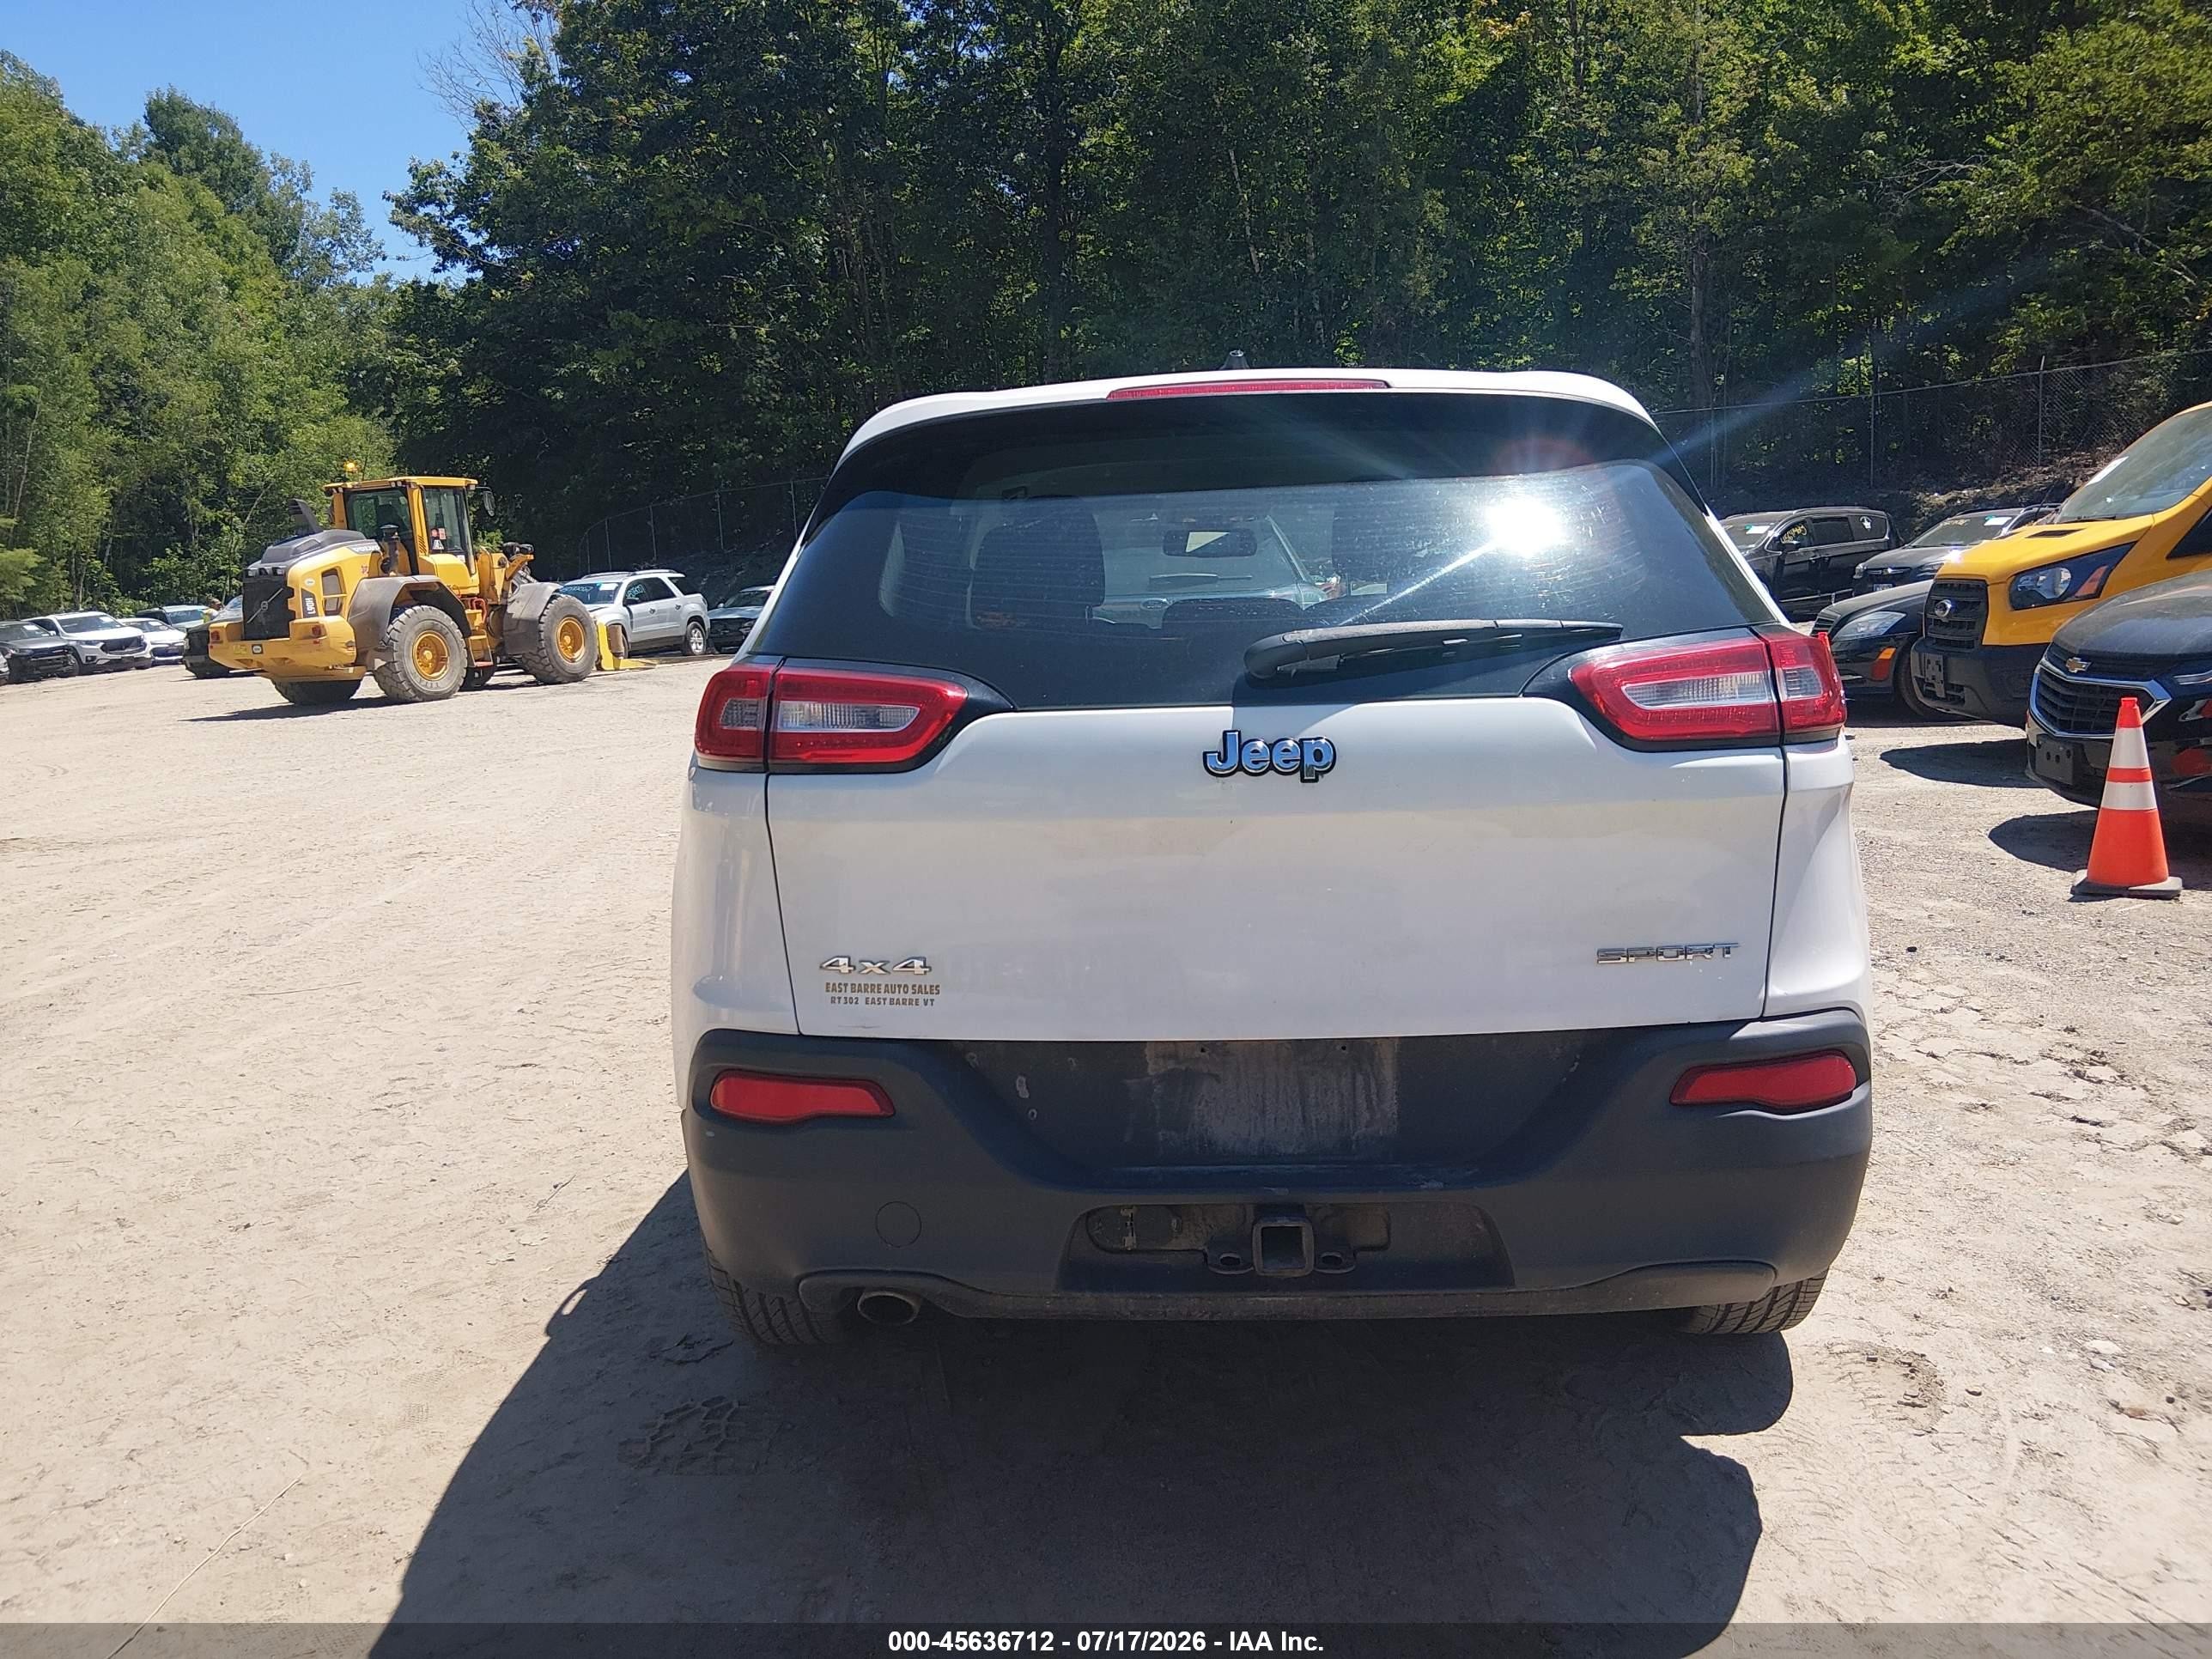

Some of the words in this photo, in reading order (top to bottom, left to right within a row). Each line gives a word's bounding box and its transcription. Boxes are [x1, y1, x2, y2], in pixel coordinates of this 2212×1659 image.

[1203, 730, 1336, 783] Jeep
[1597, 942, 1740, 964] SPORT
[819, 955, 932, 975] 4x4
[825, 981, 848, 993] EAST
[850, 982, 882, 994] BARRE
[884, 983, 909, 994] AUTO
[911, 984, 941, 995] SALES
[830, 995, 842, 1005] RT
[843, 996, 860, 1006] 302
[865, 996, 887, 1006] EAST
[889, 997, 920, 1006] BARRE
[923, 998, 935, 1007] VT
